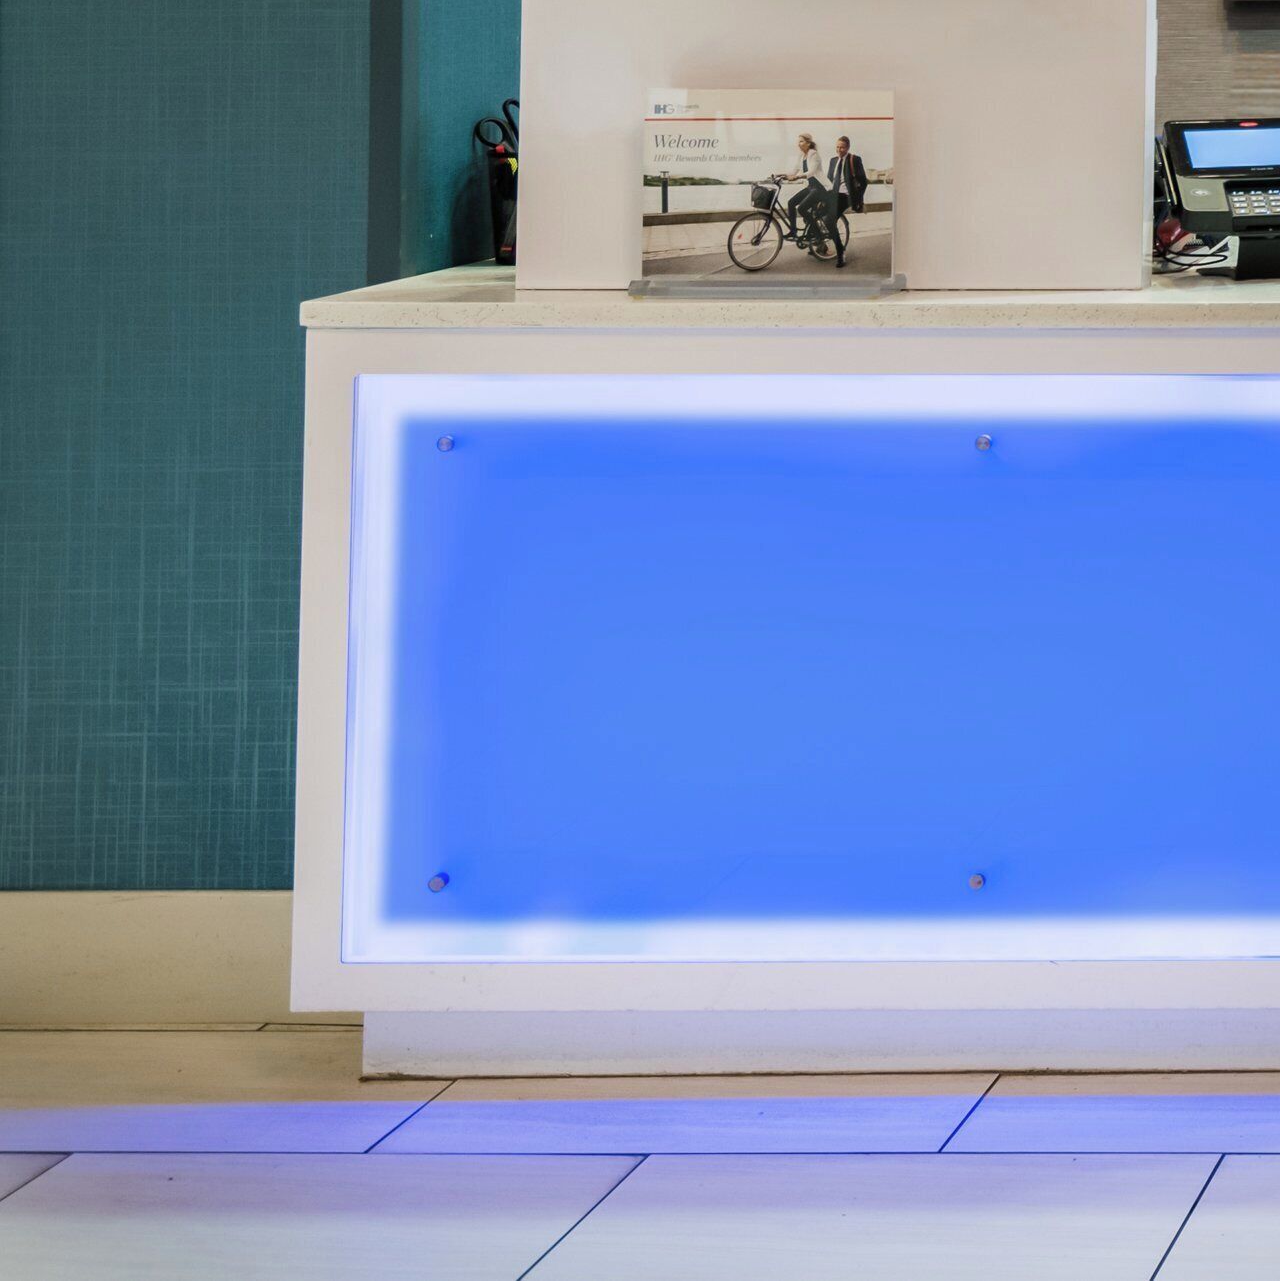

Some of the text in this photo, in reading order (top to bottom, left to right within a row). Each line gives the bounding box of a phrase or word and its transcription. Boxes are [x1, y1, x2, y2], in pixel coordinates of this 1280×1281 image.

[654, 104, 675, 114] IHG
[654, 134, 719, 148] Welcome
[728, 154, 762, 162] members
